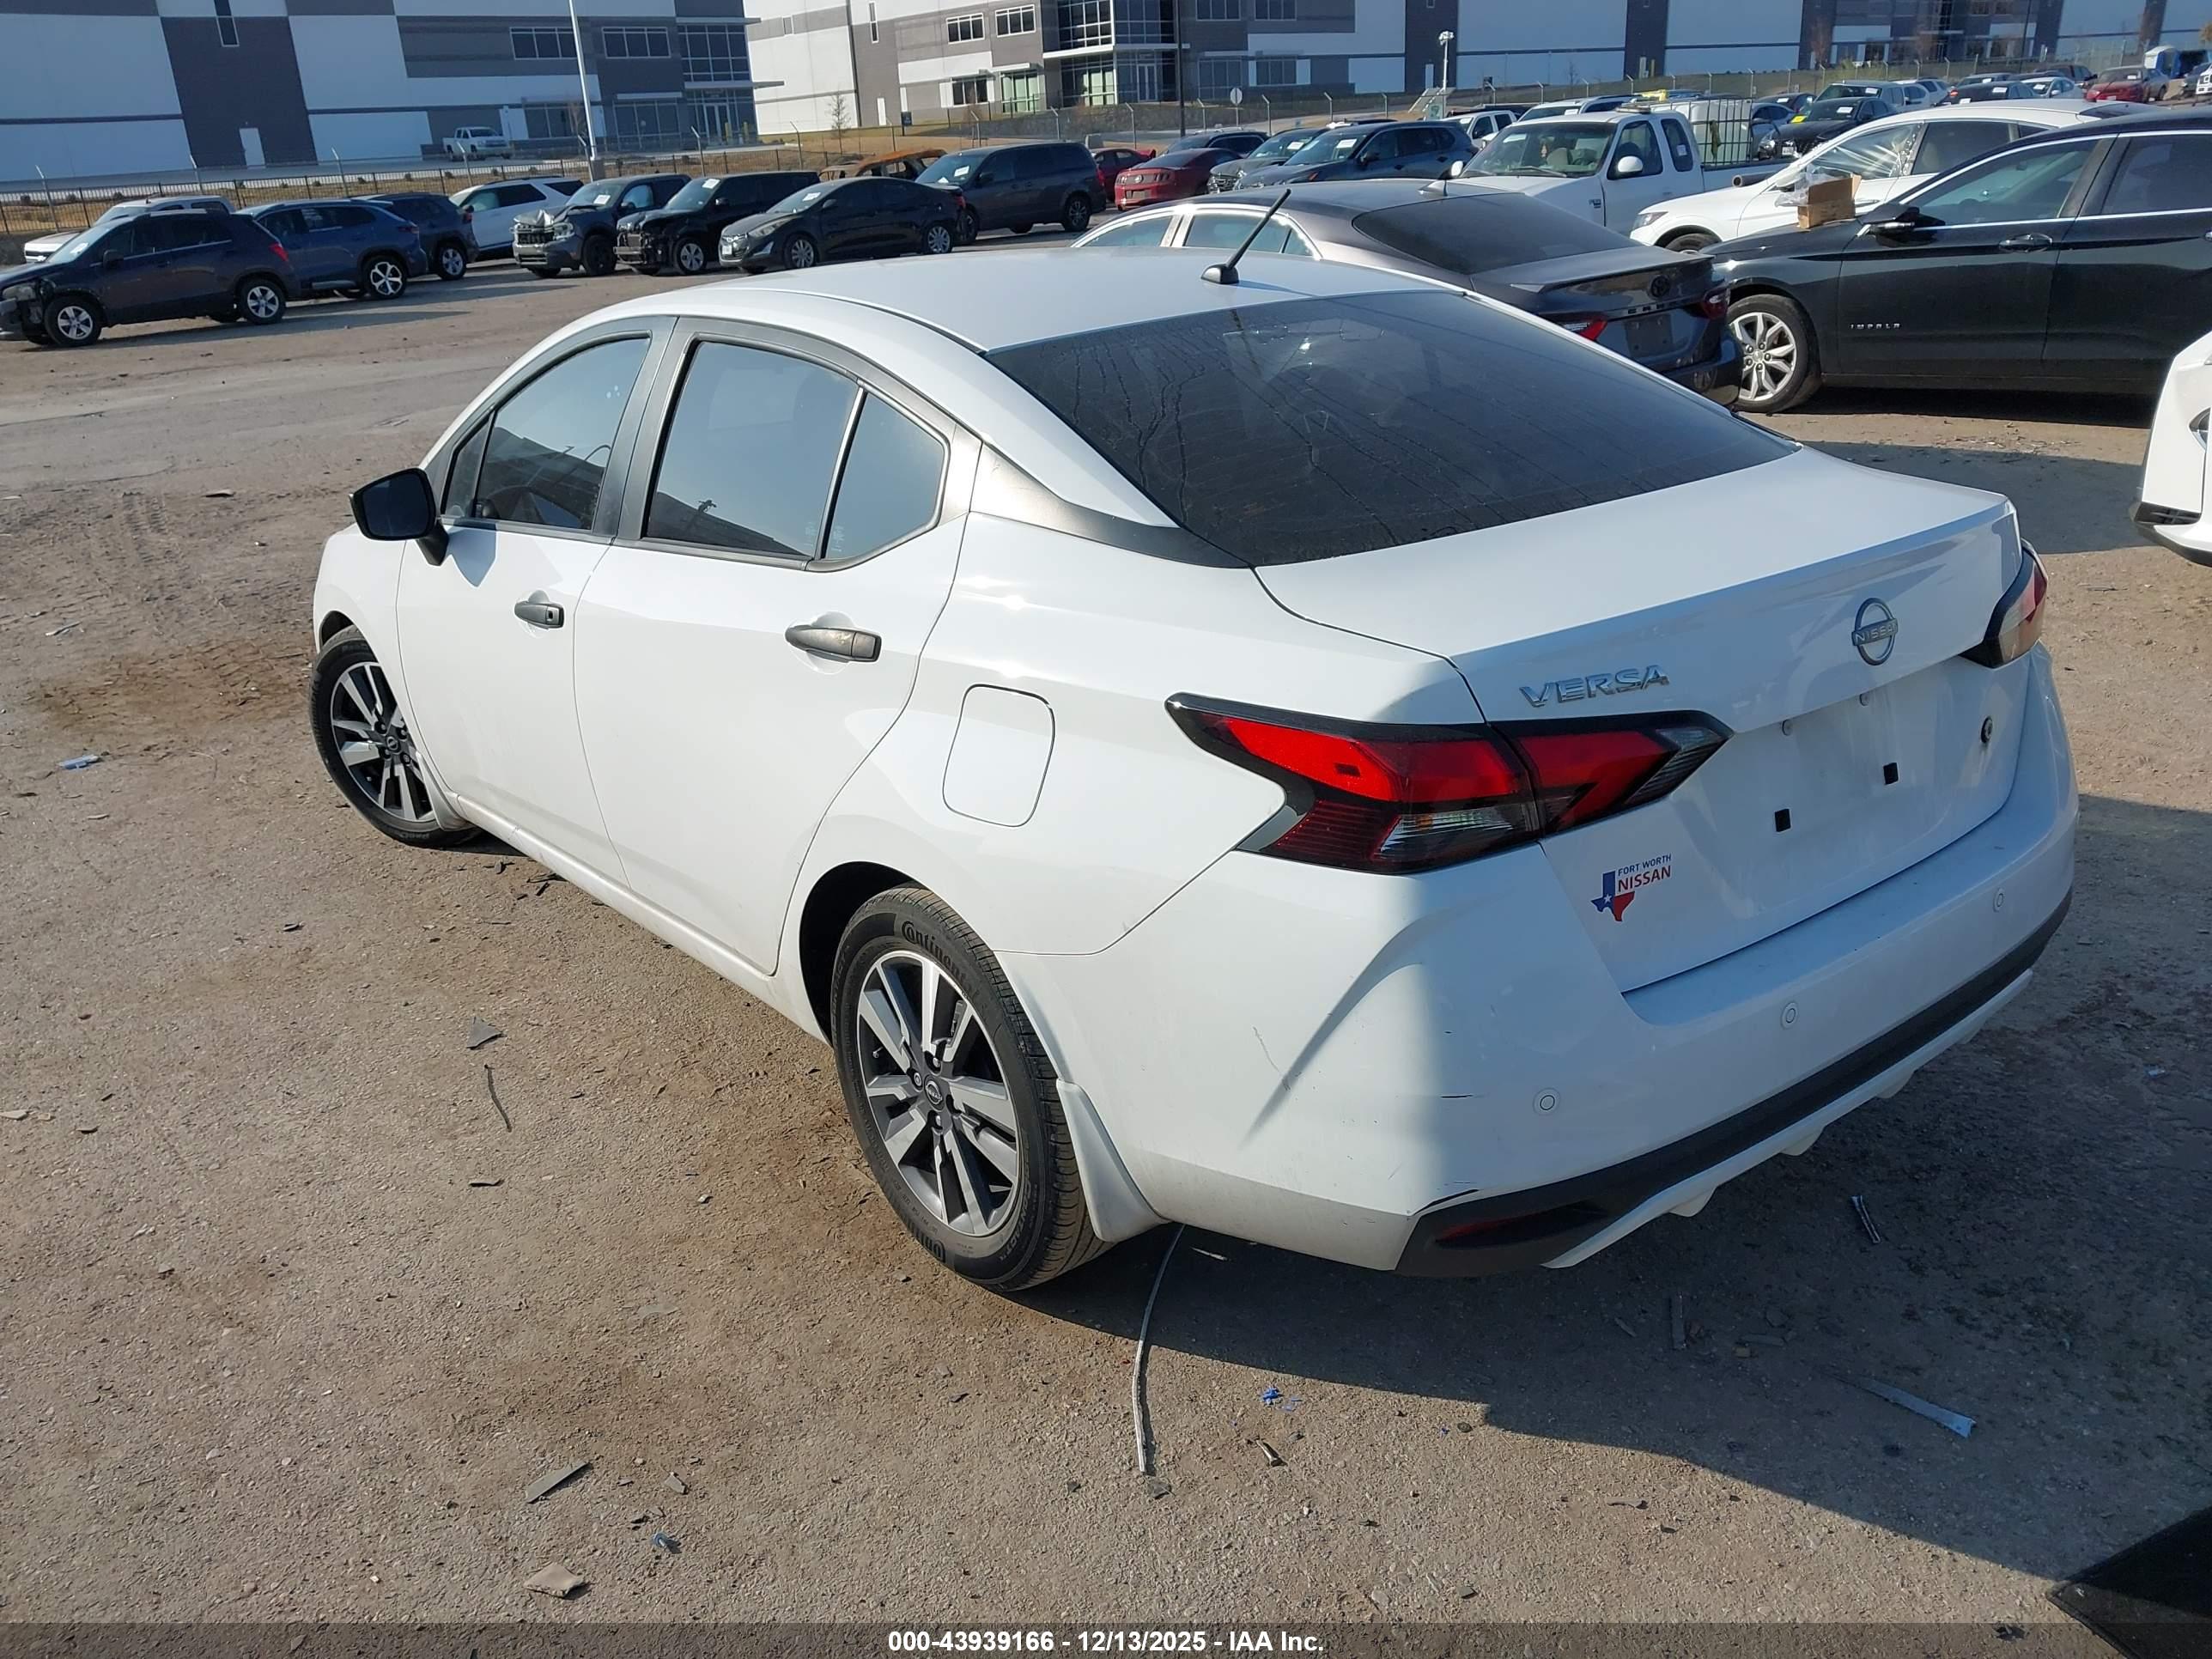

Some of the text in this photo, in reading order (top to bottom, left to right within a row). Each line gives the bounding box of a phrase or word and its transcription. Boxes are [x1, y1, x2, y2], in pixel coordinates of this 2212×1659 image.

[1519, 665, 1670, 708] VERSA
[1618, 853, 1672, 877] FORT WORTH
[1618, 865, 1671, 892] NISSAN
